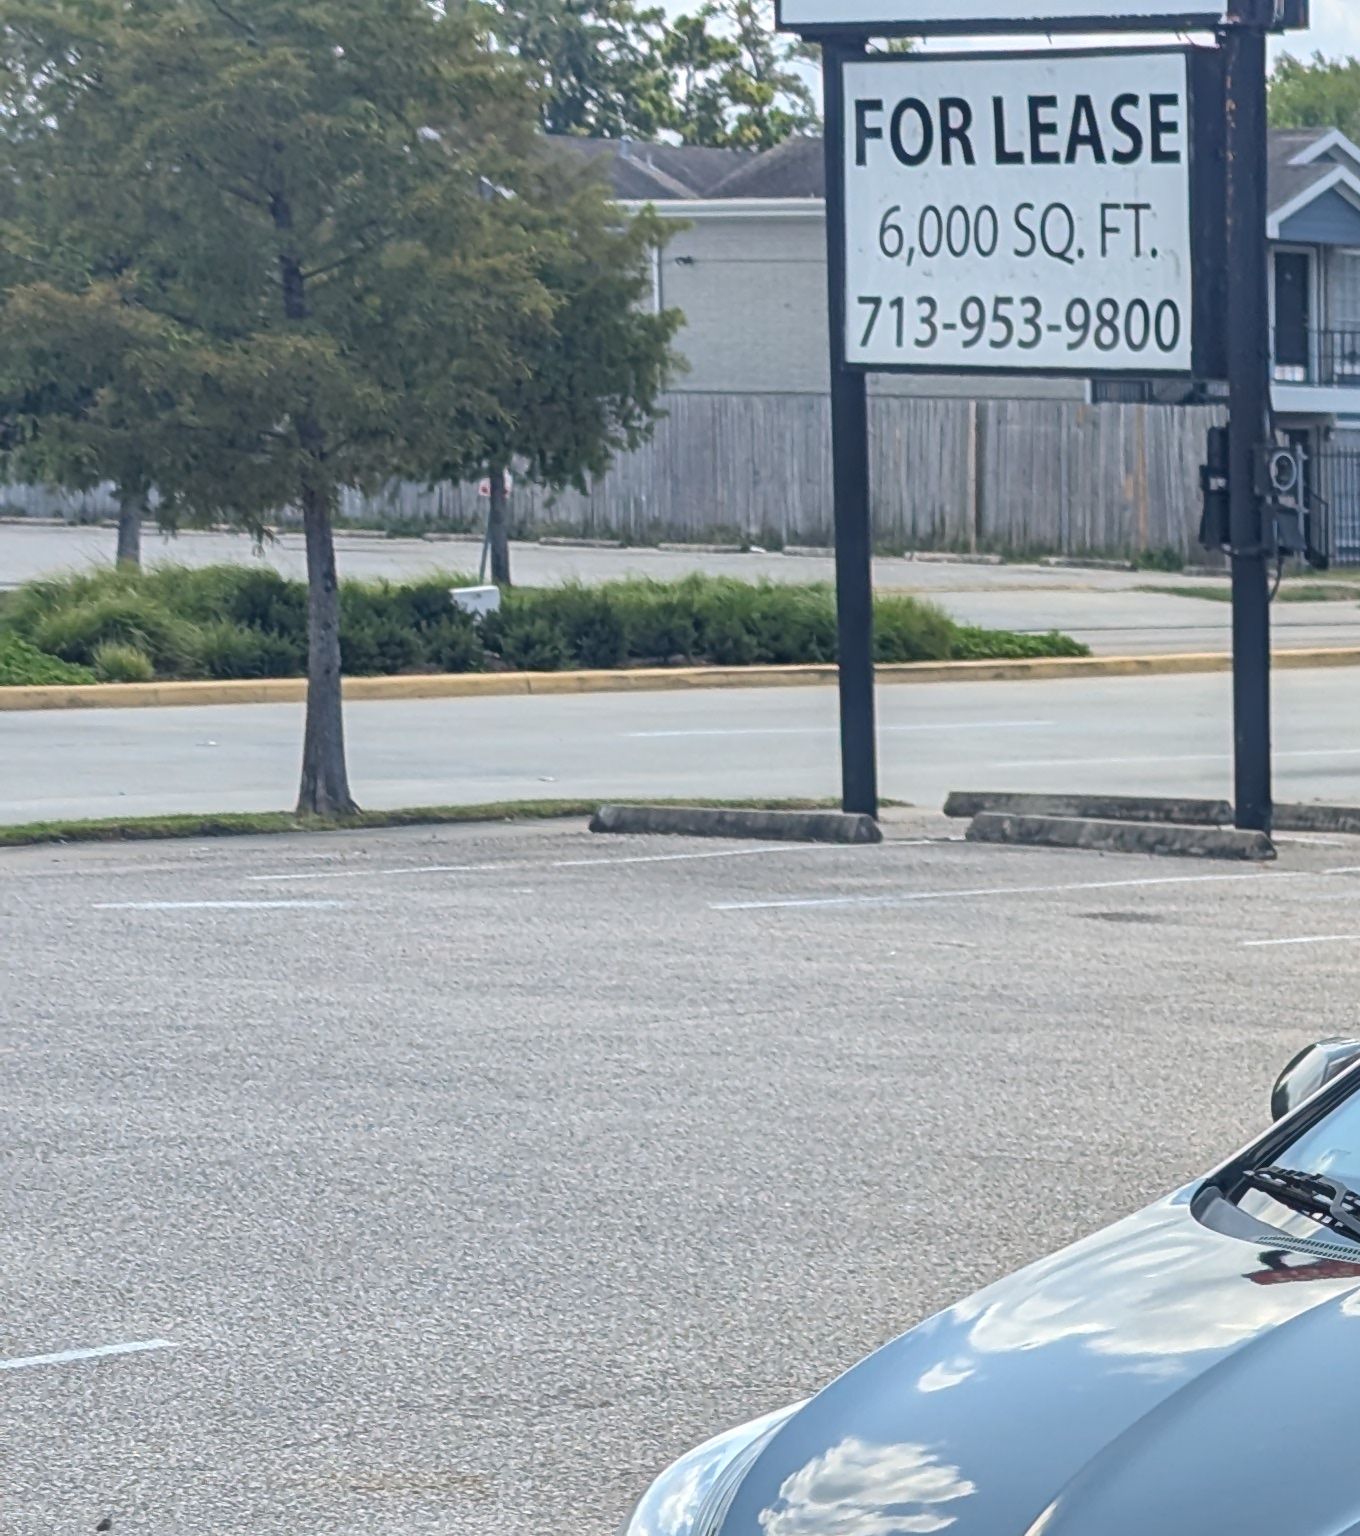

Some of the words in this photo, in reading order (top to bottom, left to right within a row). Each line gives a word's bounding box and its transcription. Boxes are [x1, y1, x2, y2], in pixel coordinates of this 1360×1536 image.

[855, 97, 975, 166] FOR
[993, 93, 1180, 165] LEASE
[880, 205, 998, 266] 6,000
[1014, 203, 1084, 264] SQ.
[1101, 203, 1157, 258] FT.
[858, 296, 1180, 352] 713-953-9800
